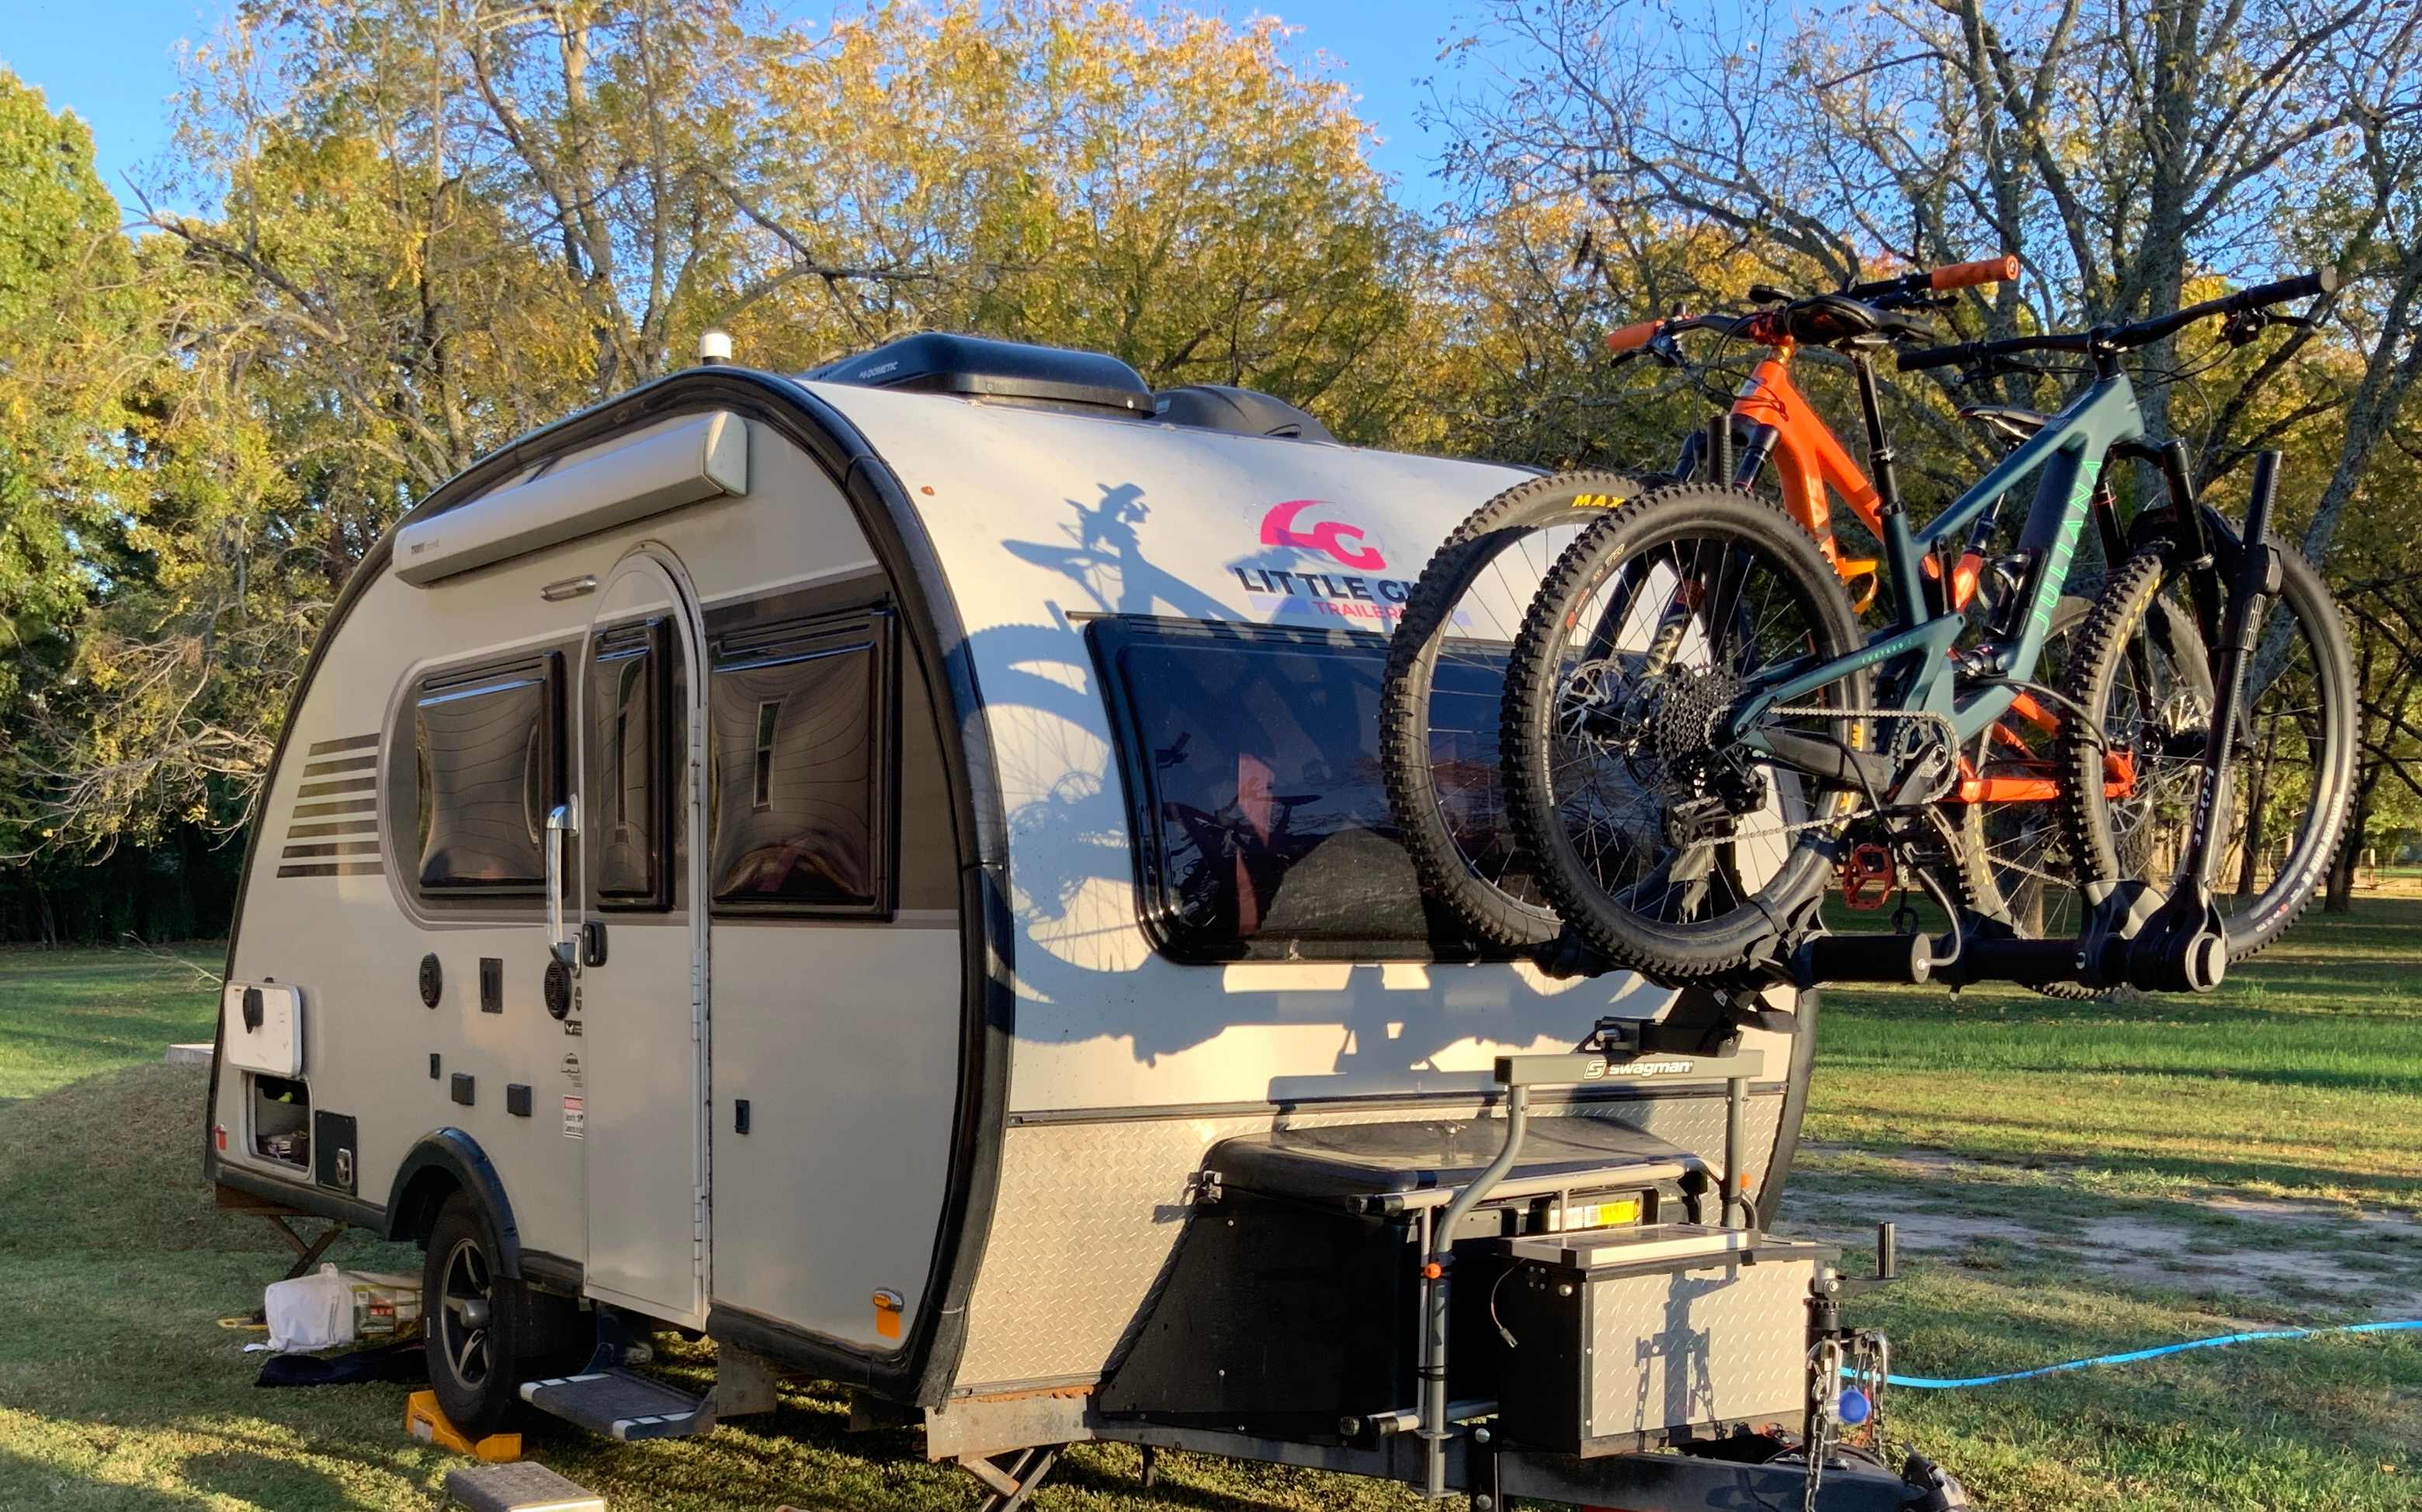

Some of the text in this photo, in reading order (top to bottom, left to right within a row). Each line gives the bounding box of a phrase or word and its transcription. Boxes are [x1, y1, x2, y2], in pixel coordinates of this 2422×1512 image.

[1571, 494, 1627, 508] MAX
[2033, 461, 2103, 636] JULIANA
[1234, 567, 1373, 601] LITTLE
[1608, 1060, 1691, 1077] swagman
